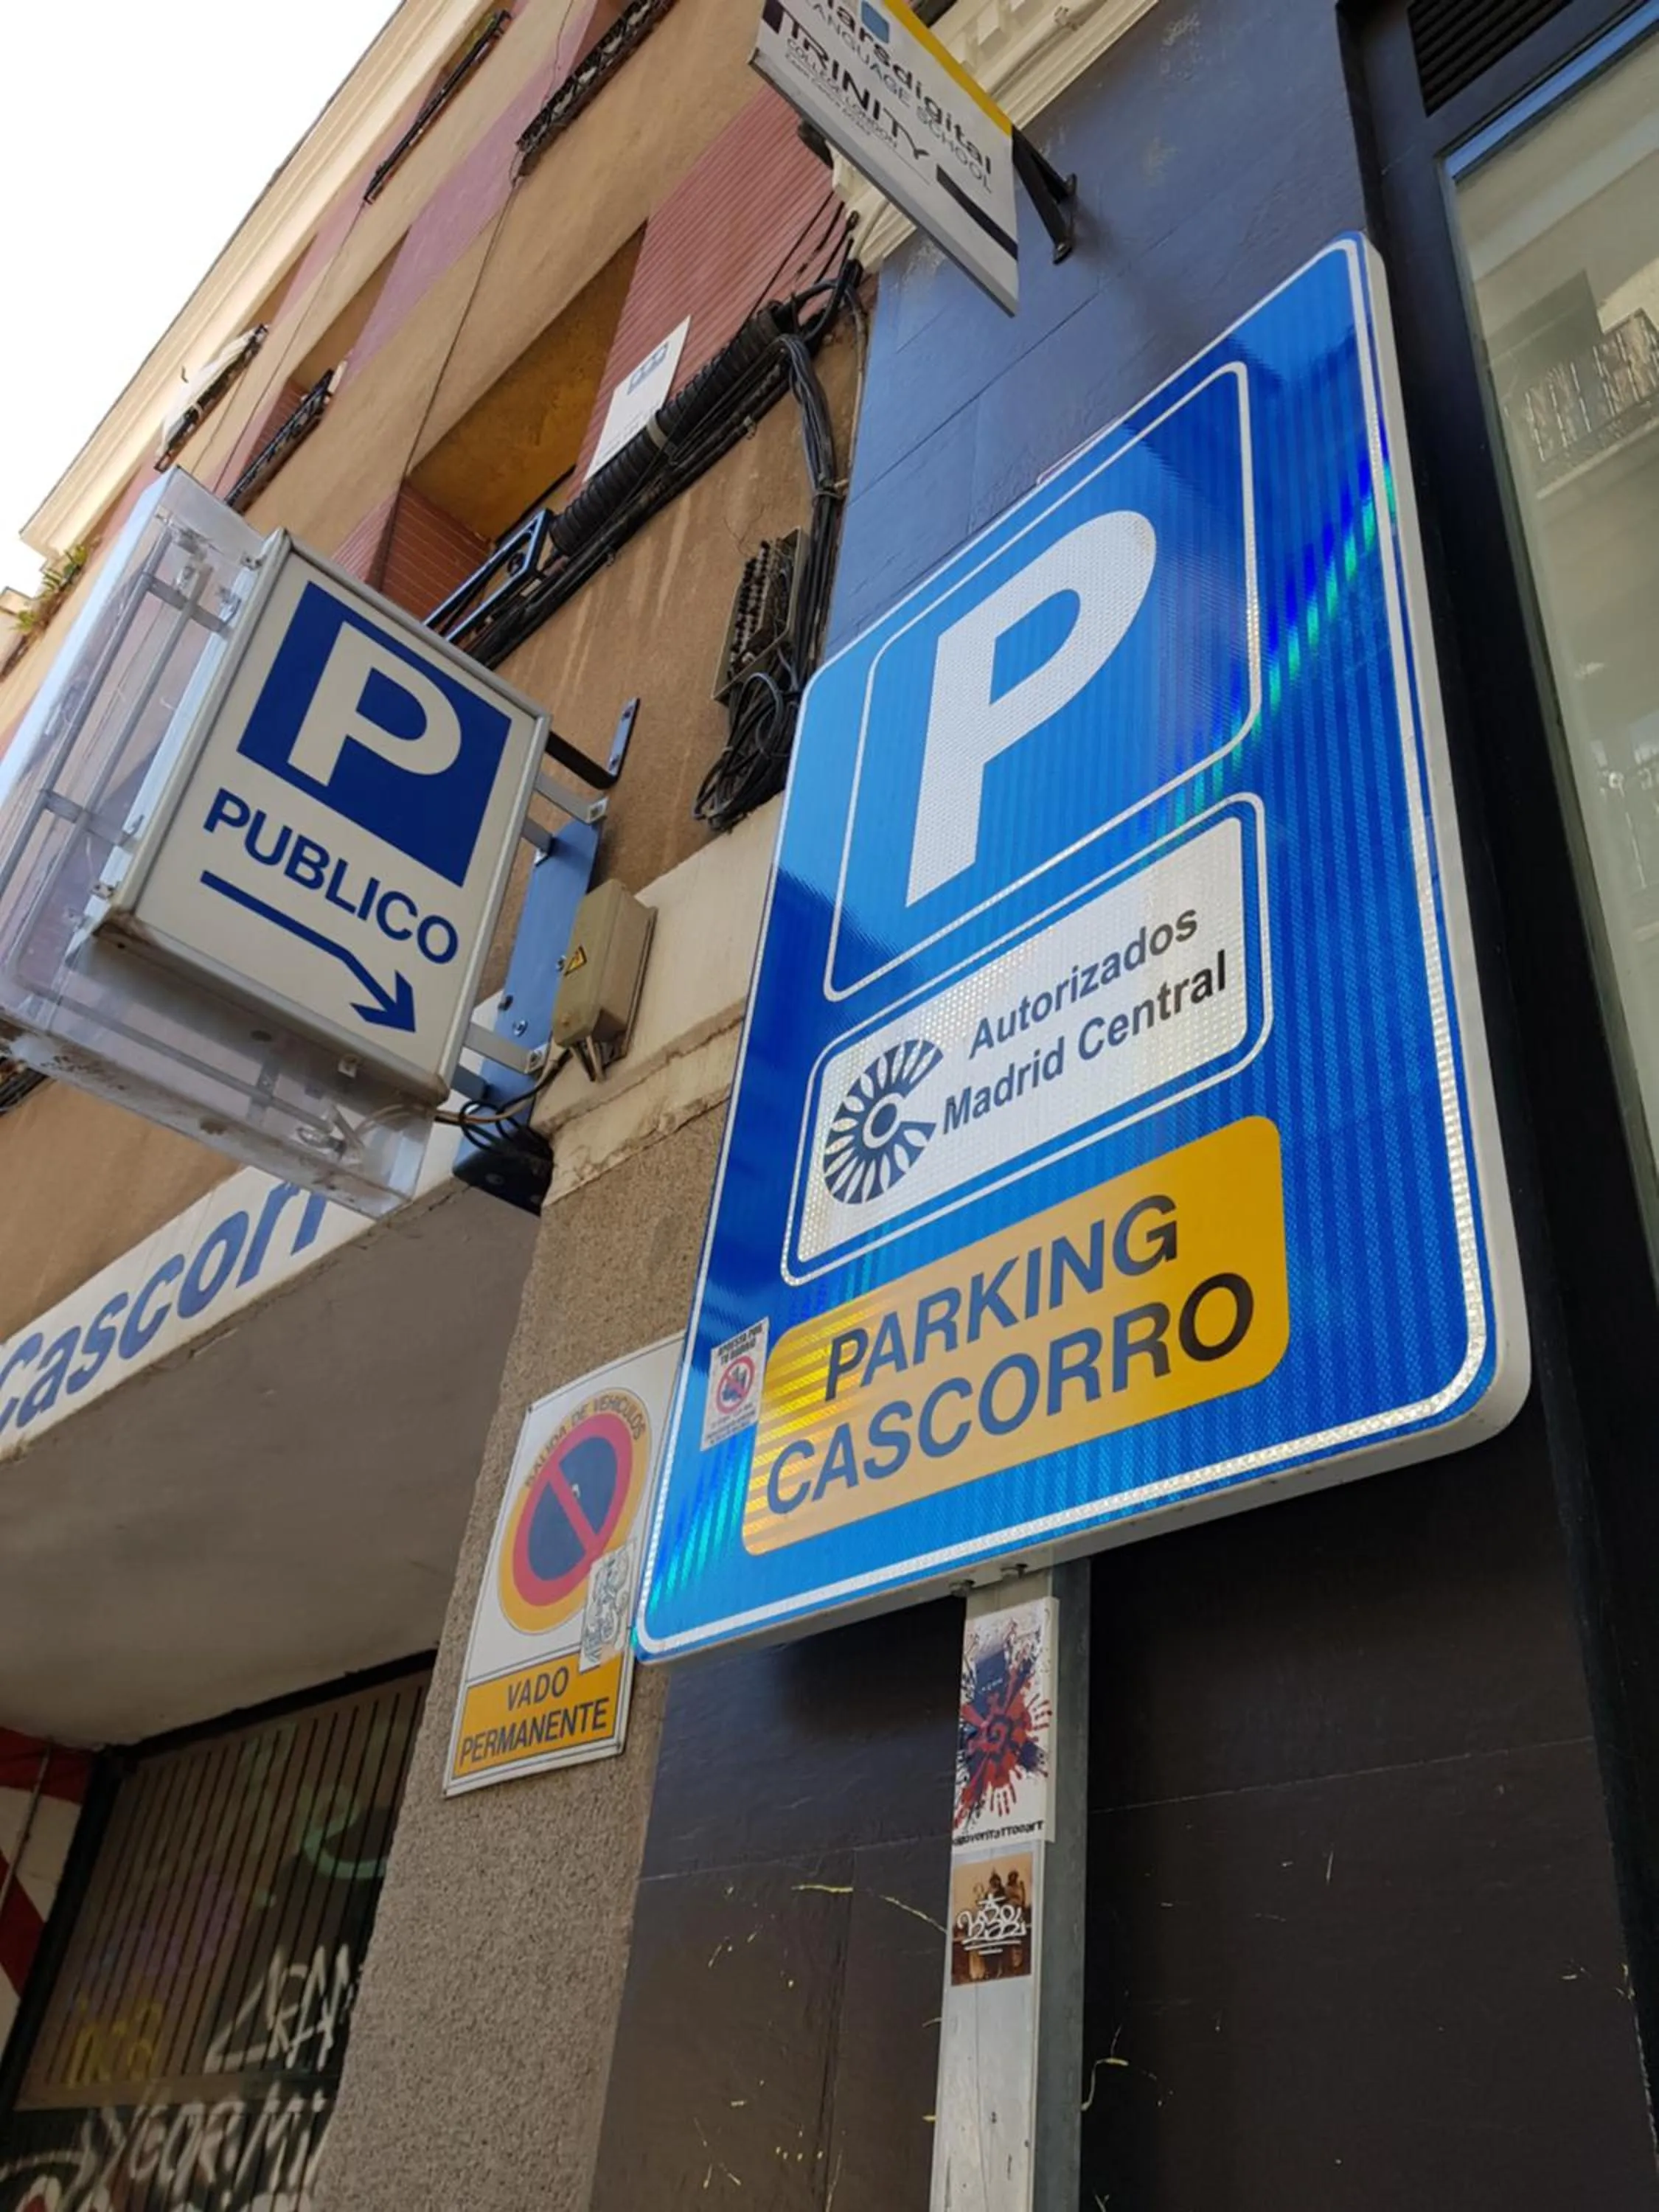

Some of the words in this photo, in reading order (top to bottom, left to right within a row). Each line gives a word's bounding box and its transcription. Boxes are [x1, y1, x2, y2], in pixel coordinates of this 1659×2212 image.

[782, 7, 930, 160] TRINITY
[811, 0, 911, 108] ANGUAGE
[917, 105, 992, 194] SCHOOL
[827, 0, 991, 175] arsdigital
[288, 621, 462, 787] P
[905, 510, 1156, 908] P
[203, 787, 459, 964] PUBLICO
[942, 1038, 1063, 1134] Madrid
[1077, 950, 1226, 1060] Central
[969, 908, 1197, 1060] Autorizados
[825, 1195, 1178, 1401] PARKING
[768, 1273, 1253, 1514] CASCORRO
[459, 1697, 610, 1767] PERMANENTE
[507, 1666, 569, 1711] VADO
